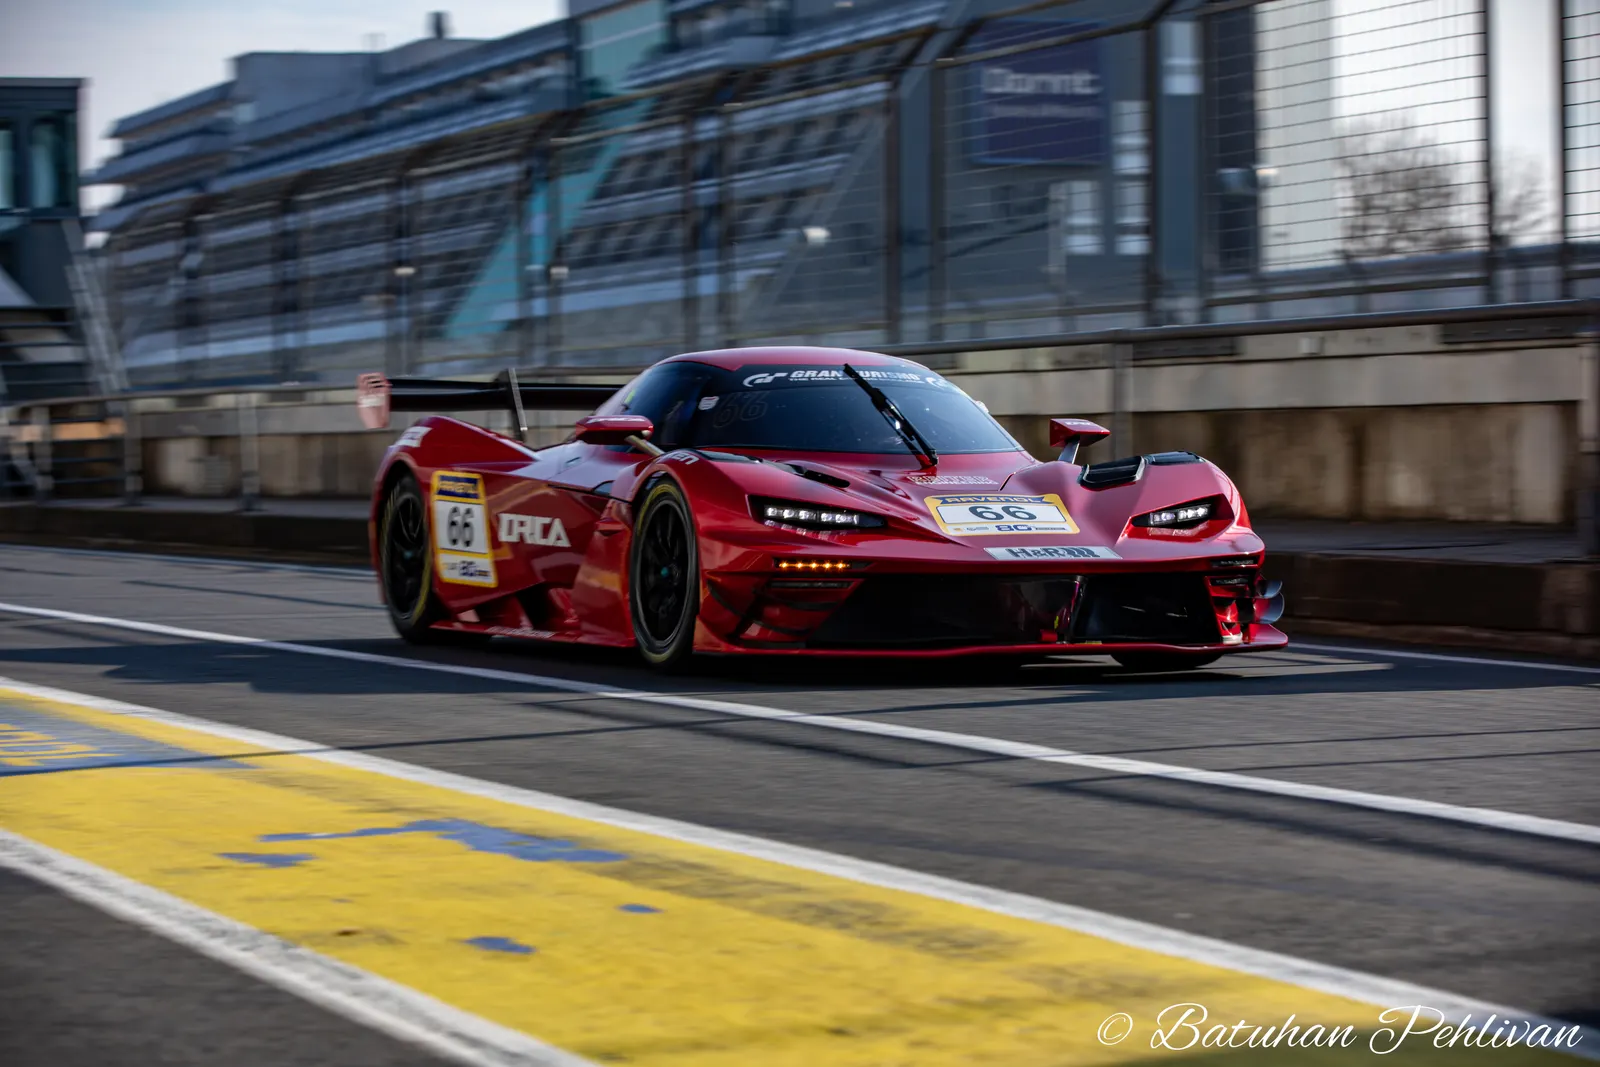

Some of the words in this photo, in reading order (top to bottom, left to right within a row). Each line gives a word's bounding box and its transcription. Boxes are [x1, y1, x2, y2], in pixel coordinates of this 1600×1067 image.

[790, 370, 843, 378] GRAN
[856, 370, 920, 381] URISMO
[968, 505, 1037, 521] 66
[447, 506, 474, 547] 66
